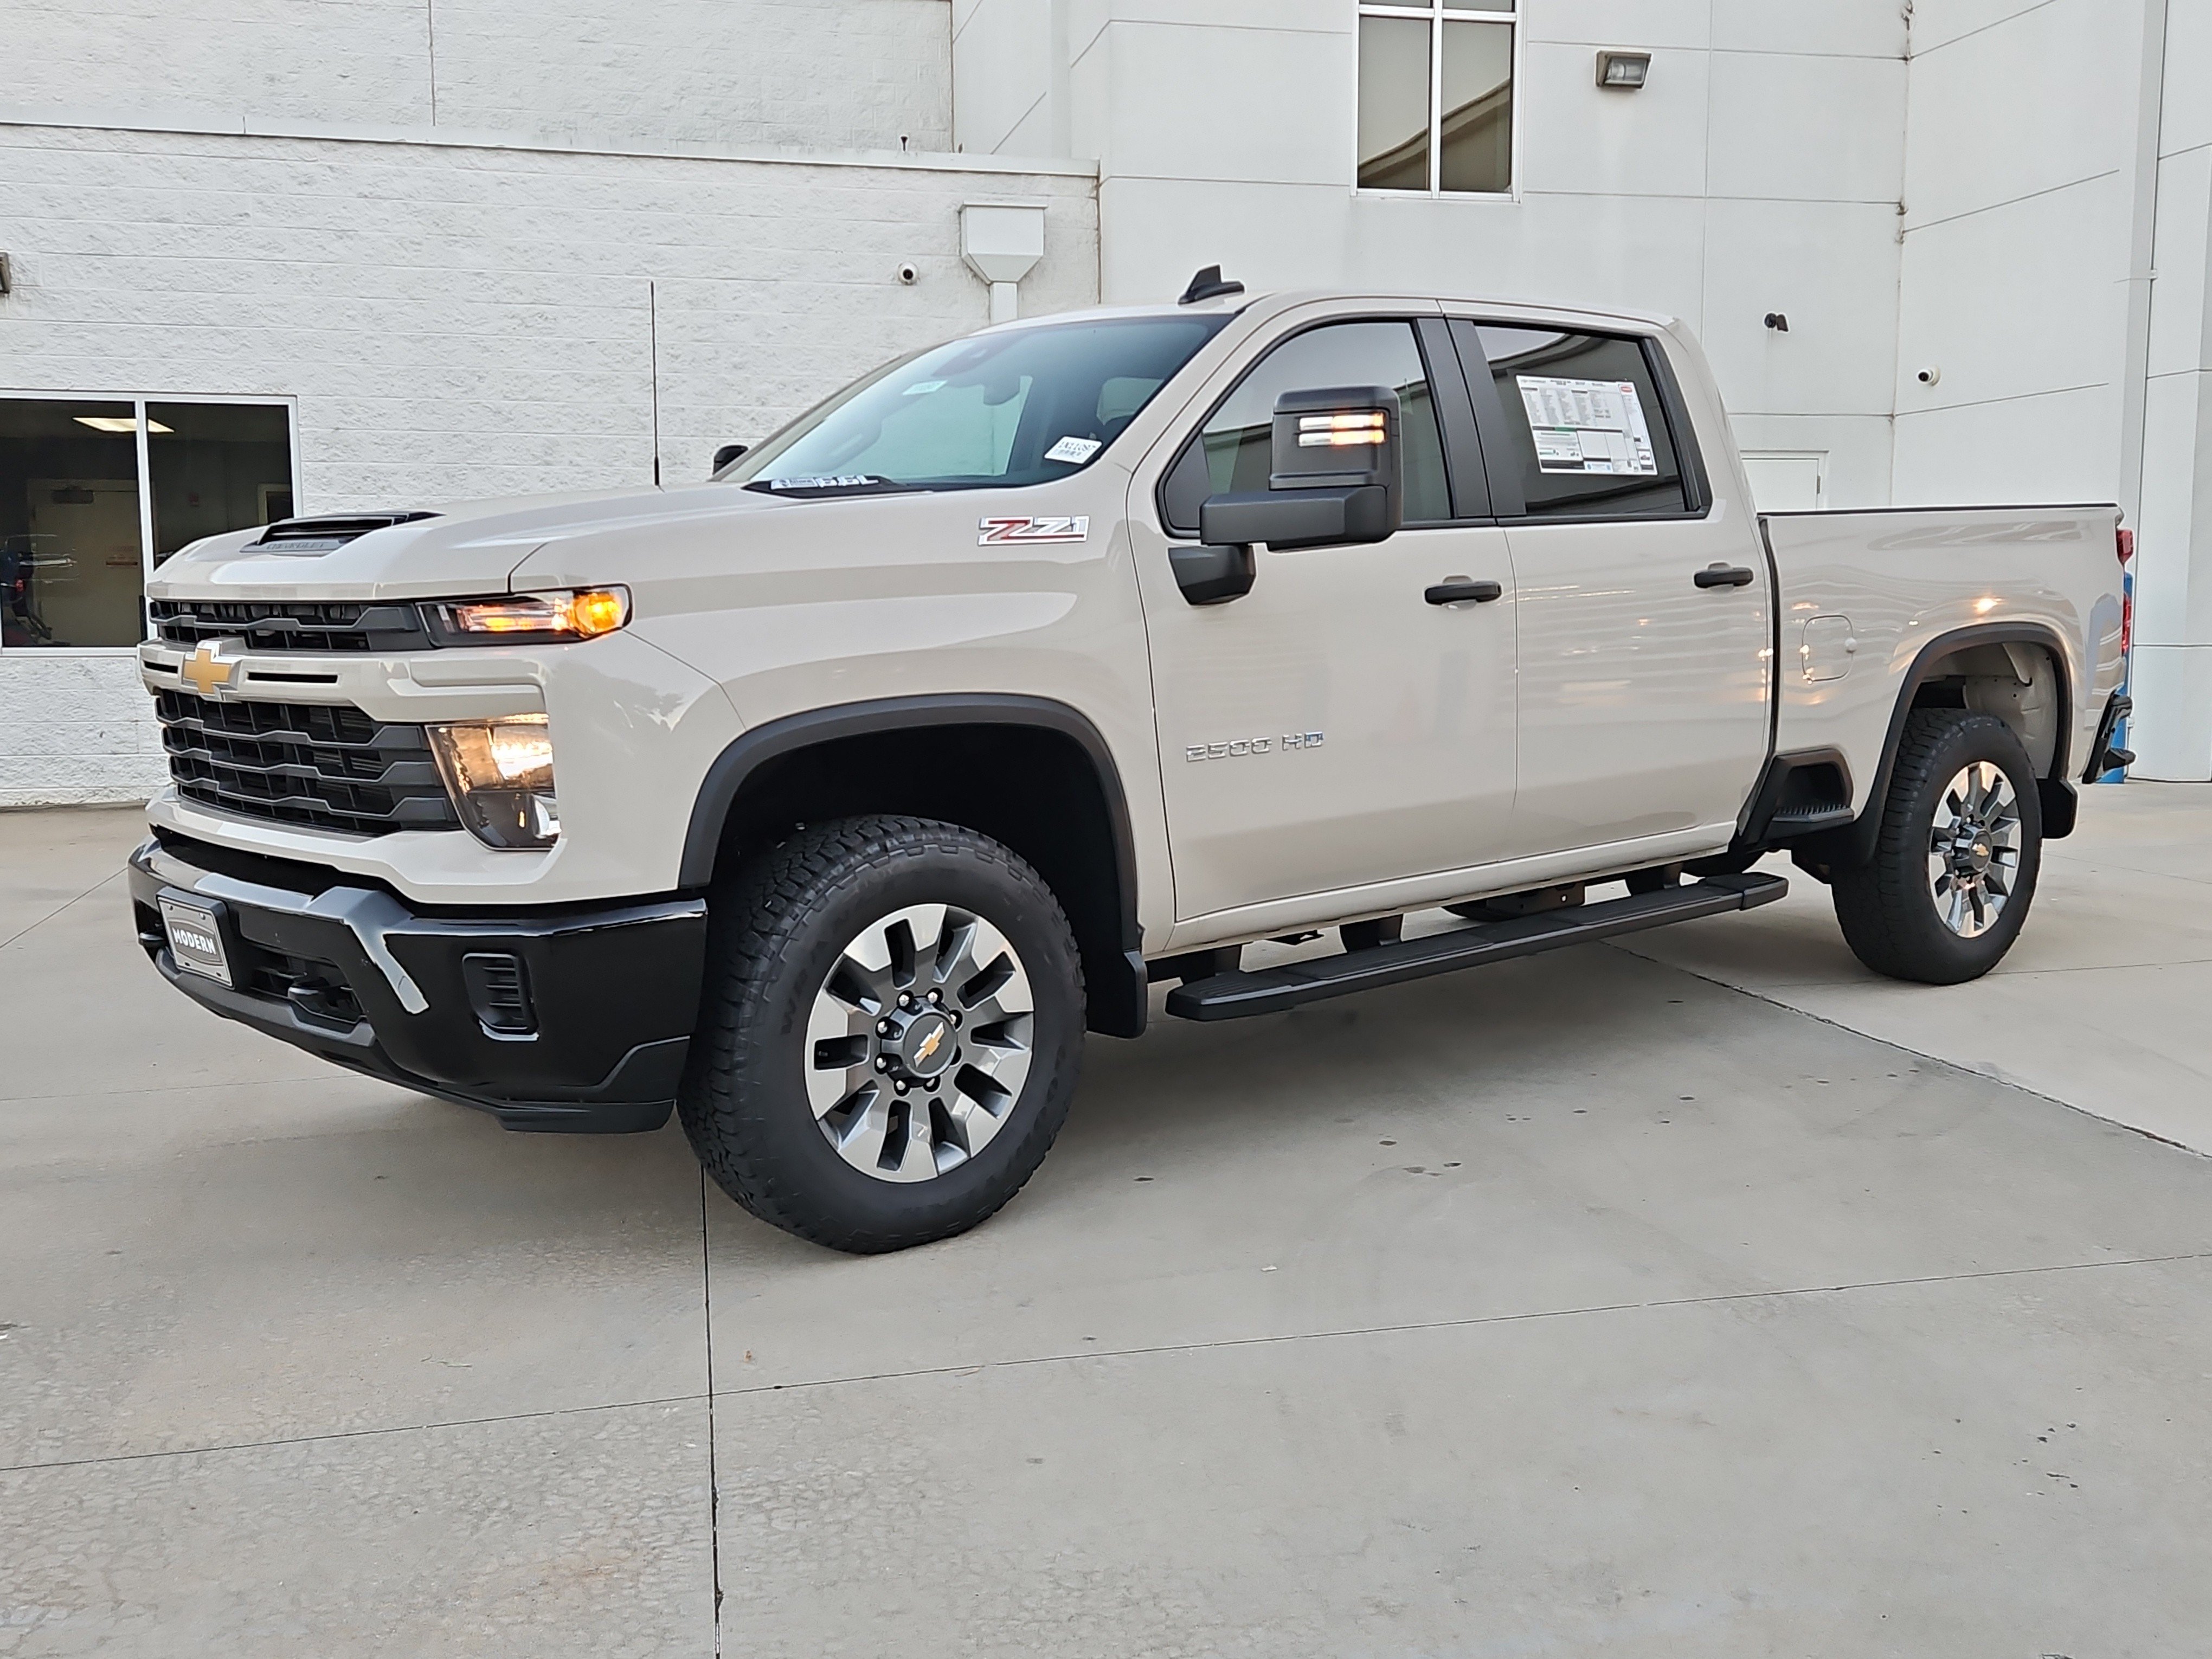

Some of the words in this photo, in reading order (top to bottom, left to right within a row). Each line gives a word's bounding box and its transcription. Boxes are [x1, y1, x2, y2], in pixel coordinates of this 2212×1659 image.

[978, 516, 1089, 545] Z71
[1186, 737, 1272, 762] 2500
[1282, 731, 1323, 751] HD
[172, 927, 217, 955] MODERN
